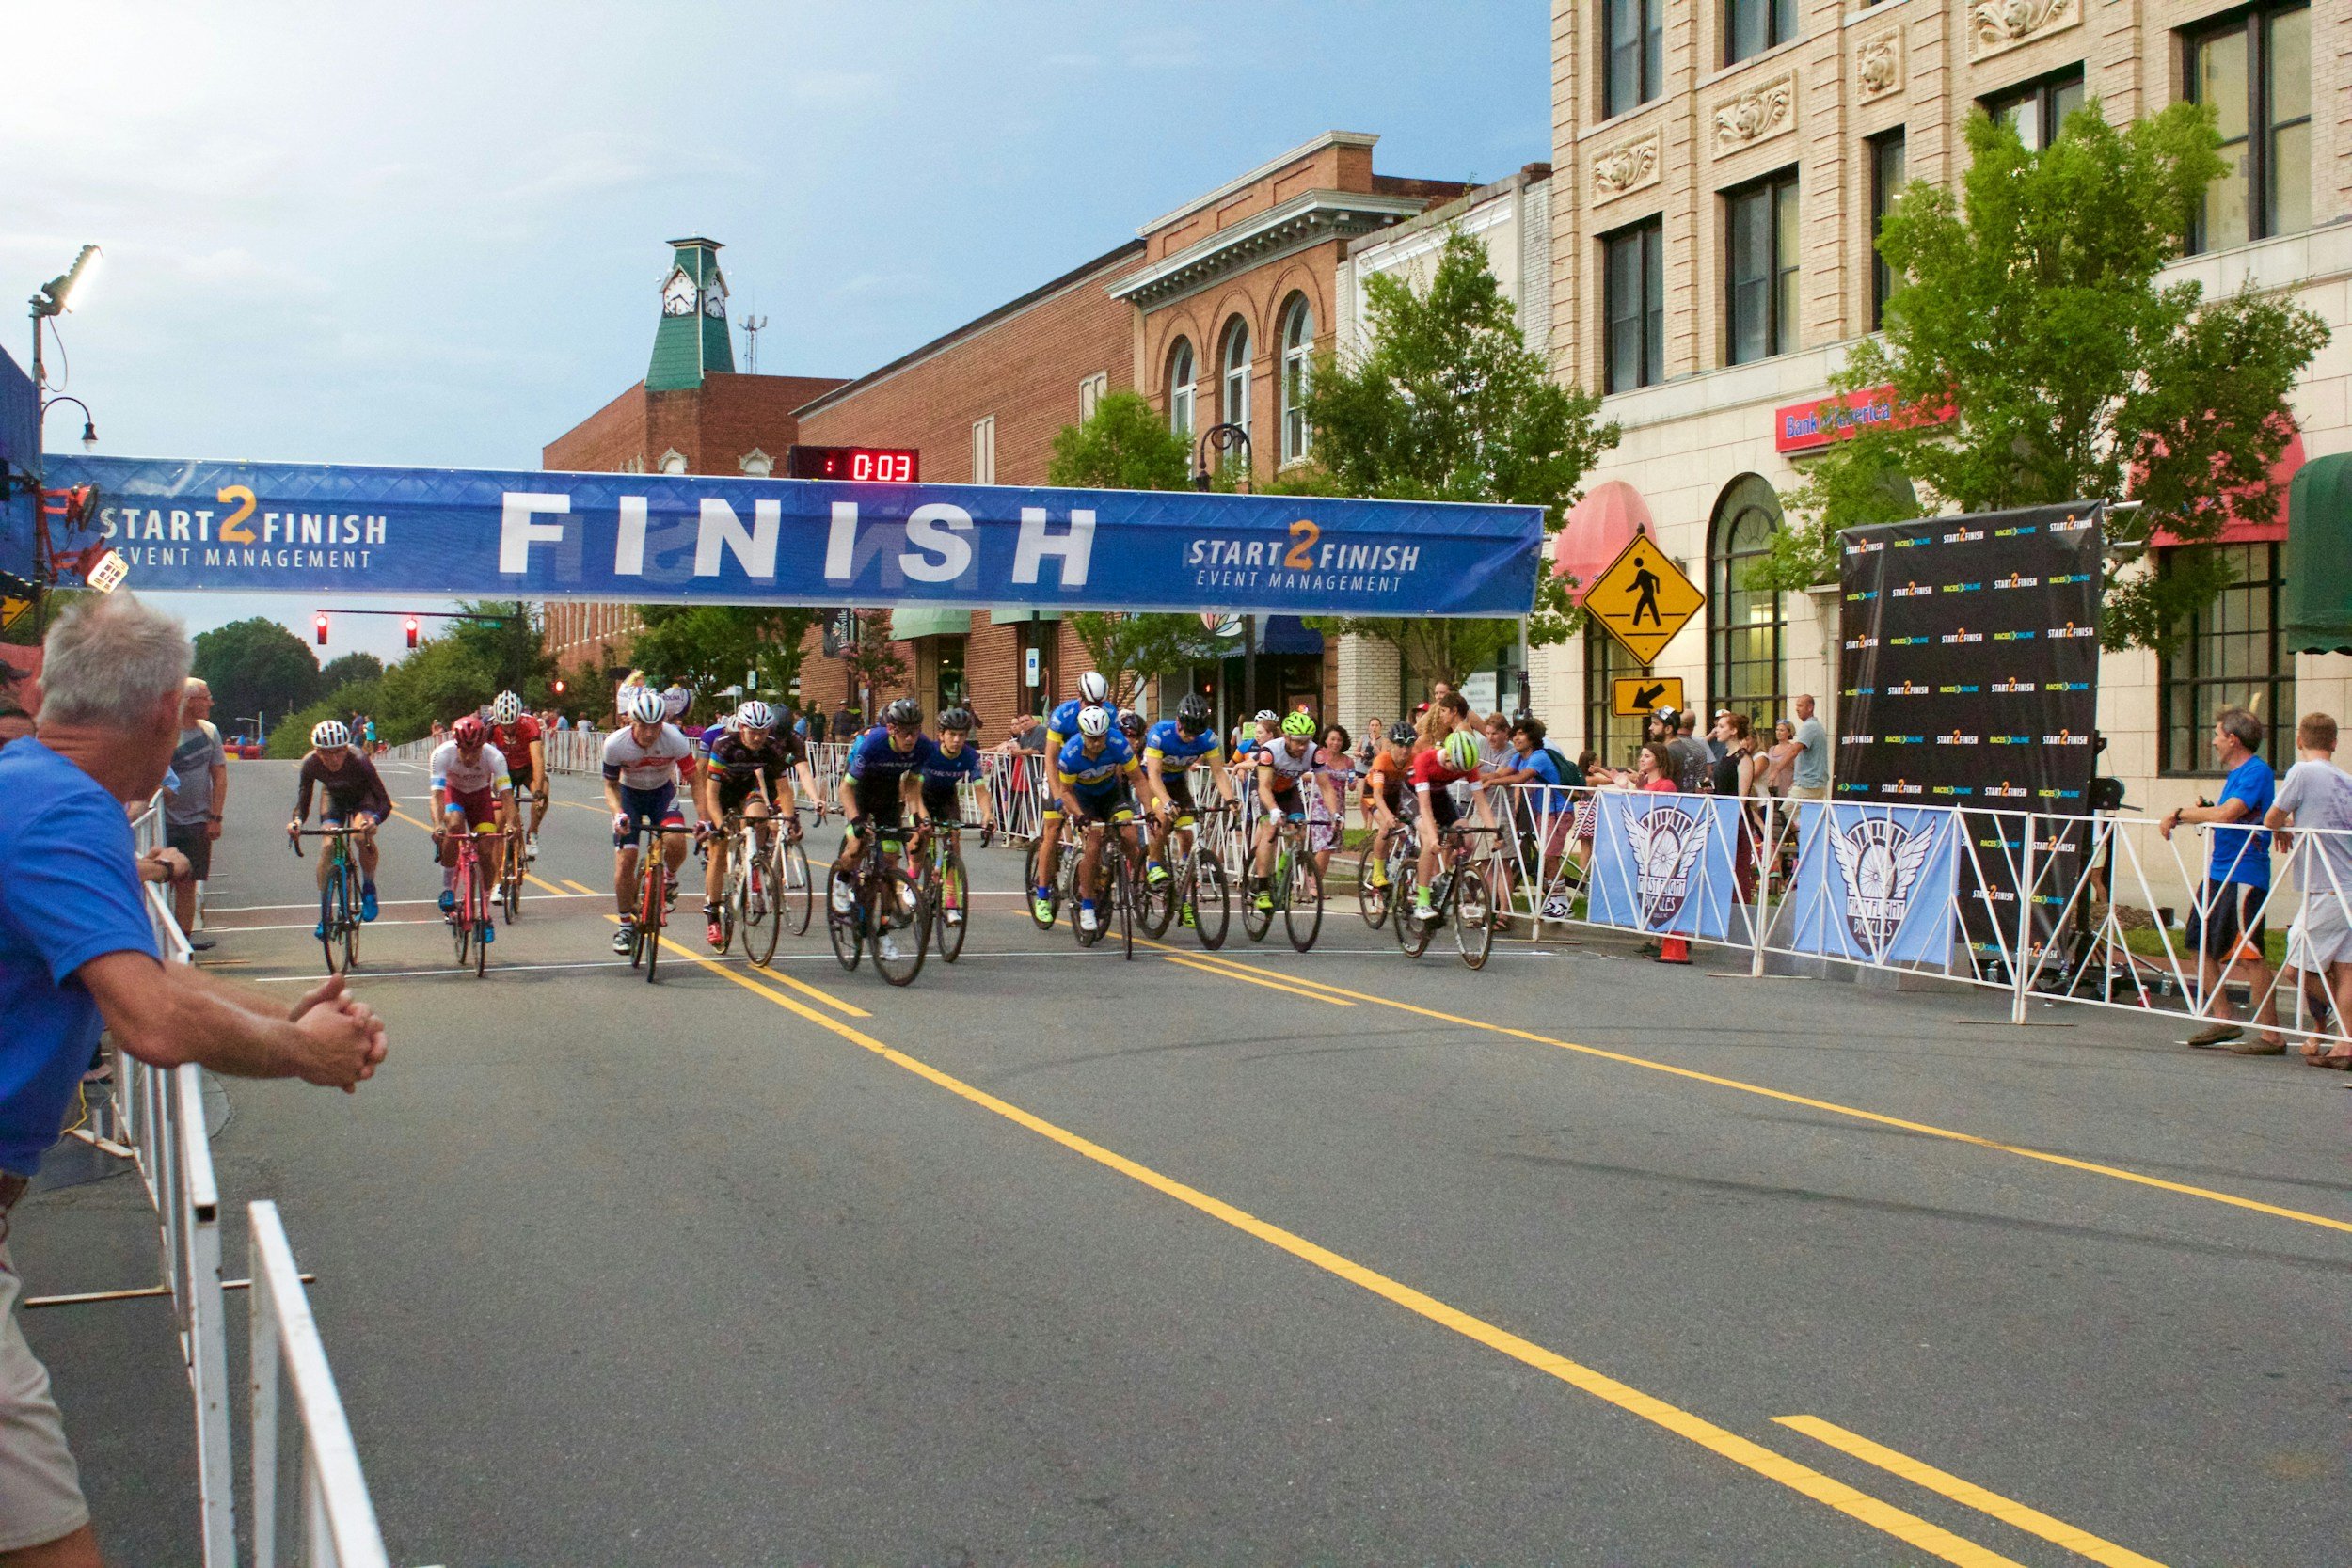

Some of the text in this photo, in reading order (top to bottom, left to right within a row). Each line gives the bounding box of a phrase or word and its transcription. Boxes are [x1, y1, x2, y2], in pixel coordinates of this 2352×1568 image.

[1786, 411, 1817, 438] Bank
[853, 454, 910, 482] 0:03
[499, 492, 1096, 586] FINISH
[205, 548, 371, 568] MANAGEMENT
[1197, 570, 1402, 592] EVENT MANAGEMENT
[1639, 877, 1659, 894] FST
